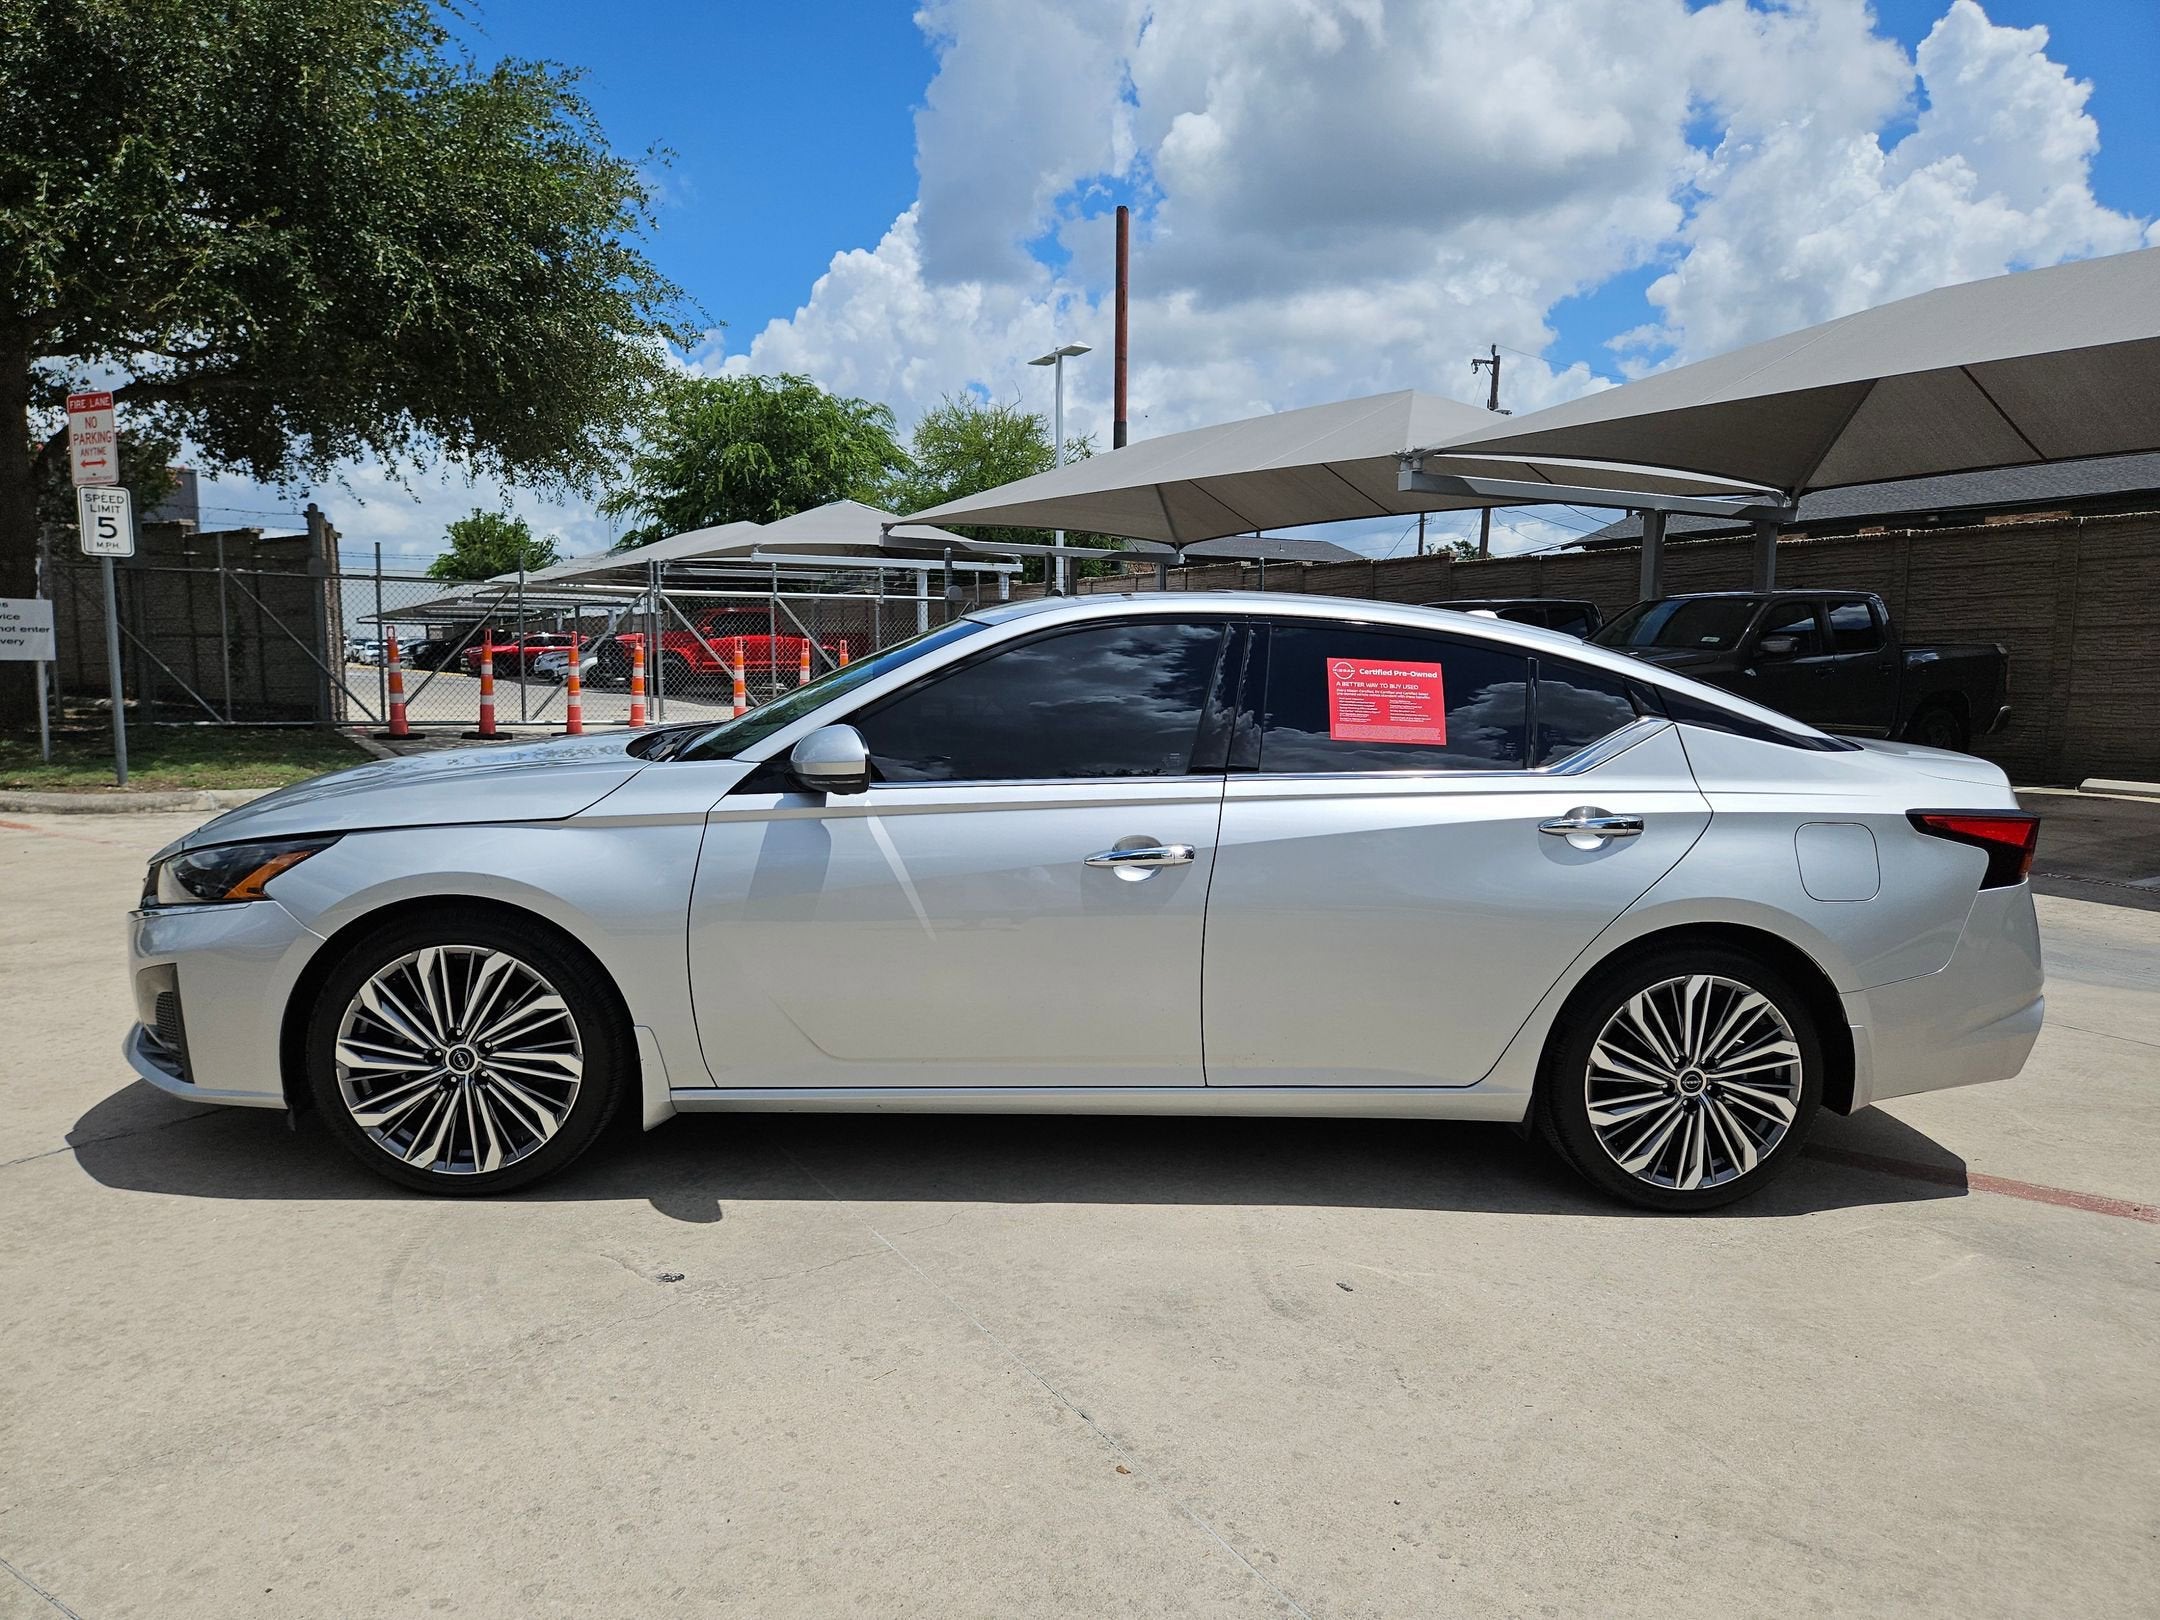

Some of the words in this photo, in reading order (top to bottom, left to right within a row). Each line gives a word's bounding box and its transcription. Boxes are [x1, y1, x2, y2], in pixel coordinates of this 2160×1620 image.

[69, 399, 86, 409] FIRE
[89, 396, 111, 408] LANE
[84, 416, 97, 429] NO
[73, 430, 112, 446] PARKING
[80, 447, 107, 457] ANYTIME
[85, 493, 125, 504] SPEED
[90, 504, 121, 513] LIMIT
[97, 516, 118, 539] 5
[1359, 668, 1393, 676] Certified
[1393, 670, 1438, 678] Pre-Owned
